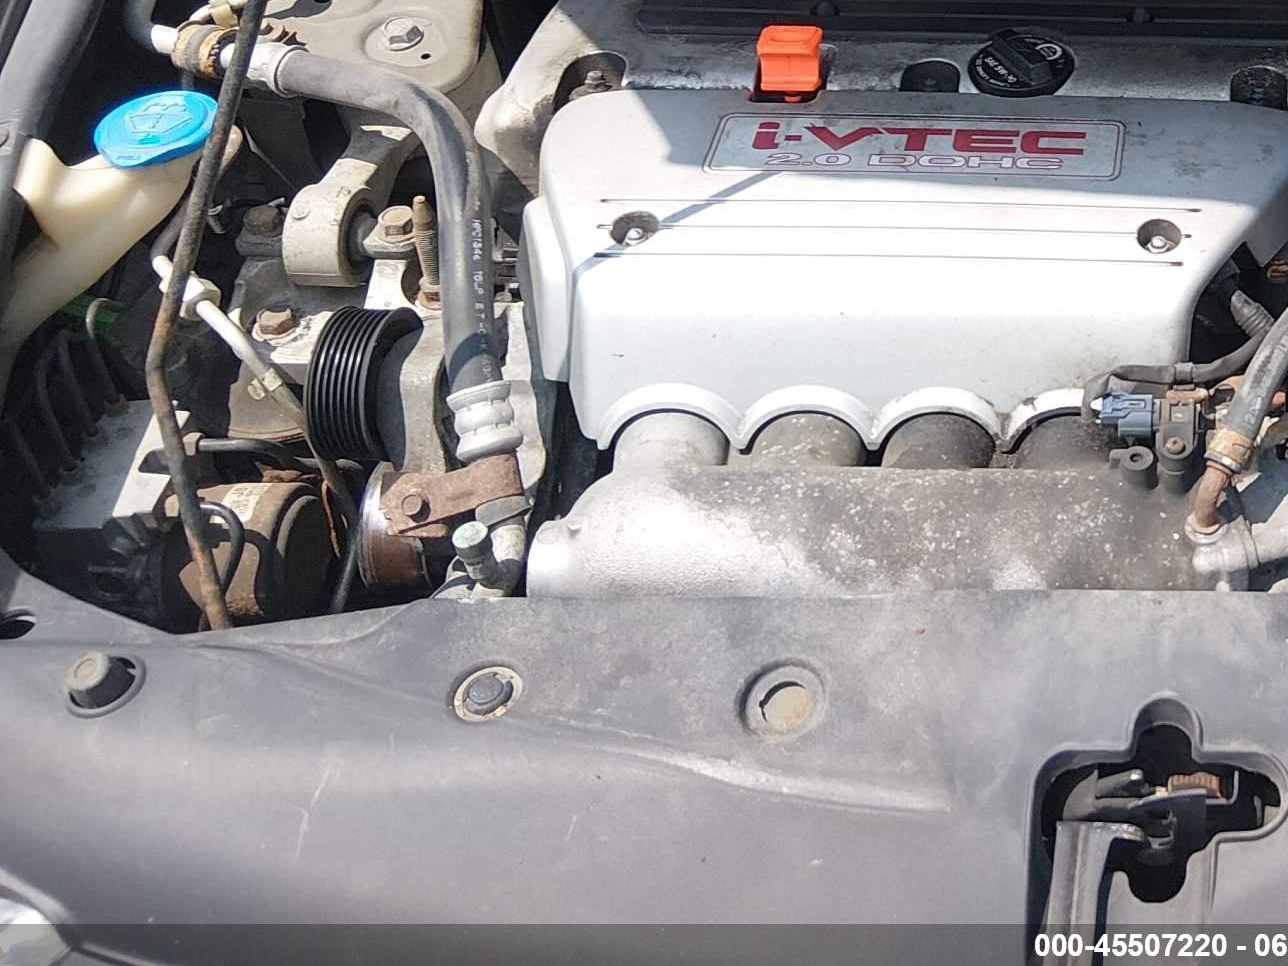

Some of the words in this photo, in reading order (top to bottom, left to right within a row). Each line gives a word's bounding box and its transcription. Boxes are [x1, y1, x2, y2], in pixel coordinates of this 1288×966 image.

[752, 121, 1087, 156] i-VTEC
[765, 152, 850, 168] 2.0
[867, 153, 1063, 171] DOHC
